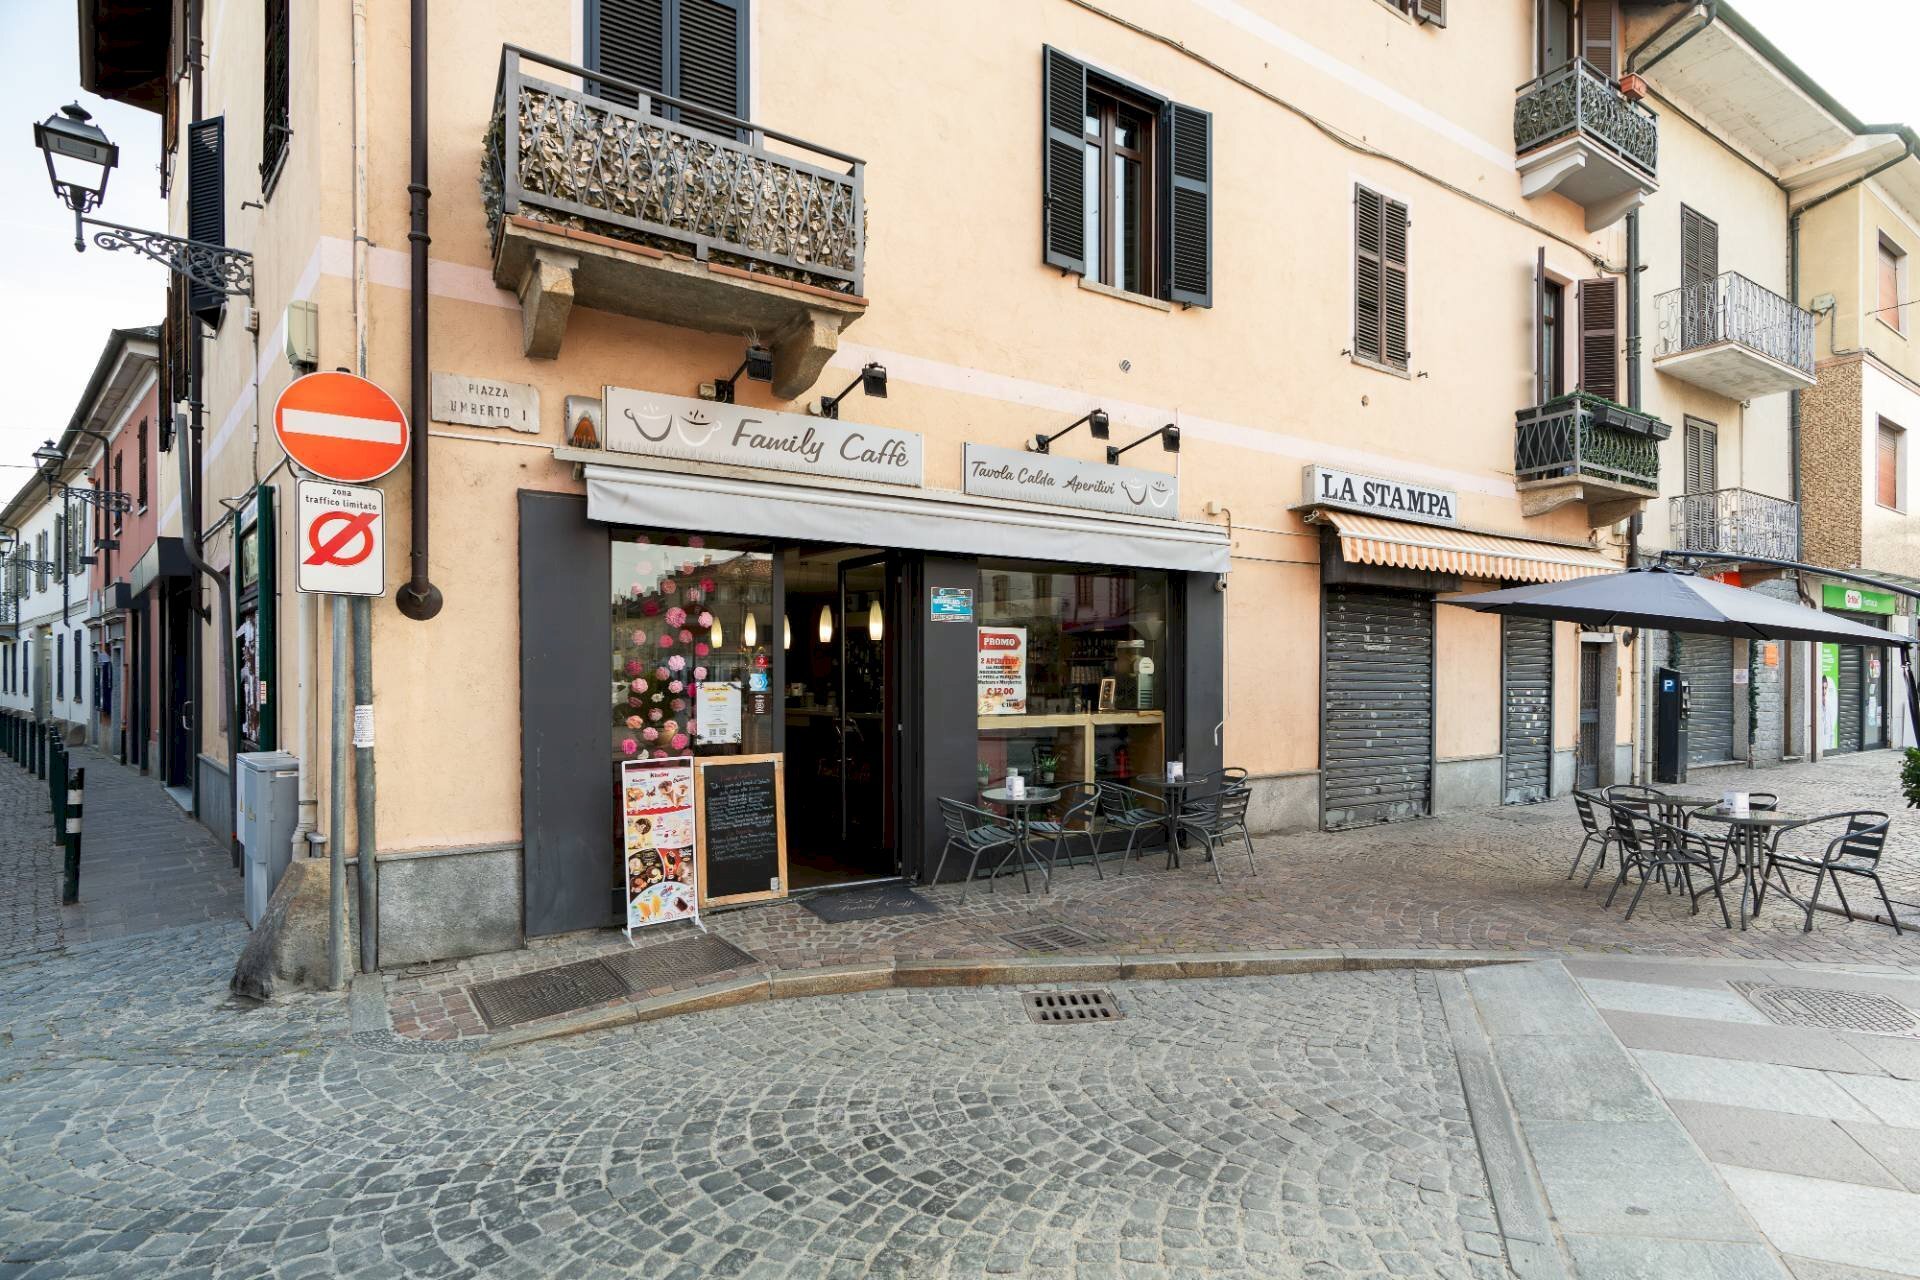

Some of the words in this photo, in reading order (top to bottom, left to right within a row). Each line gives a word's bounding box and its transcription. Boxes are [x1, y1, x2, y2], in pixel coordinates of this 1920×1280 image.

[468, 383, 509, 398] PIAZZA
[450, 400, 510, 419] UMBERTO
[731, 418, 825, 464] Family
[839, 432, 910, 468] Caffè
[971, 460, 1015, 481] Tavola
[1017, 467, 1055, 487] Calda
[1062, 474, 1116, 495] Aperitivi
[332, 488, 352, 497] zona
[1321, 473, 1357, 503] LA
[1363, 480, 1452, 519] STAMPA
[305, 494, 340, 506] traffico
[342, 499, 377, 510] limitato
[983, 637, 1016, 646] PROMO
[1664, 680, 1674, 691] P
